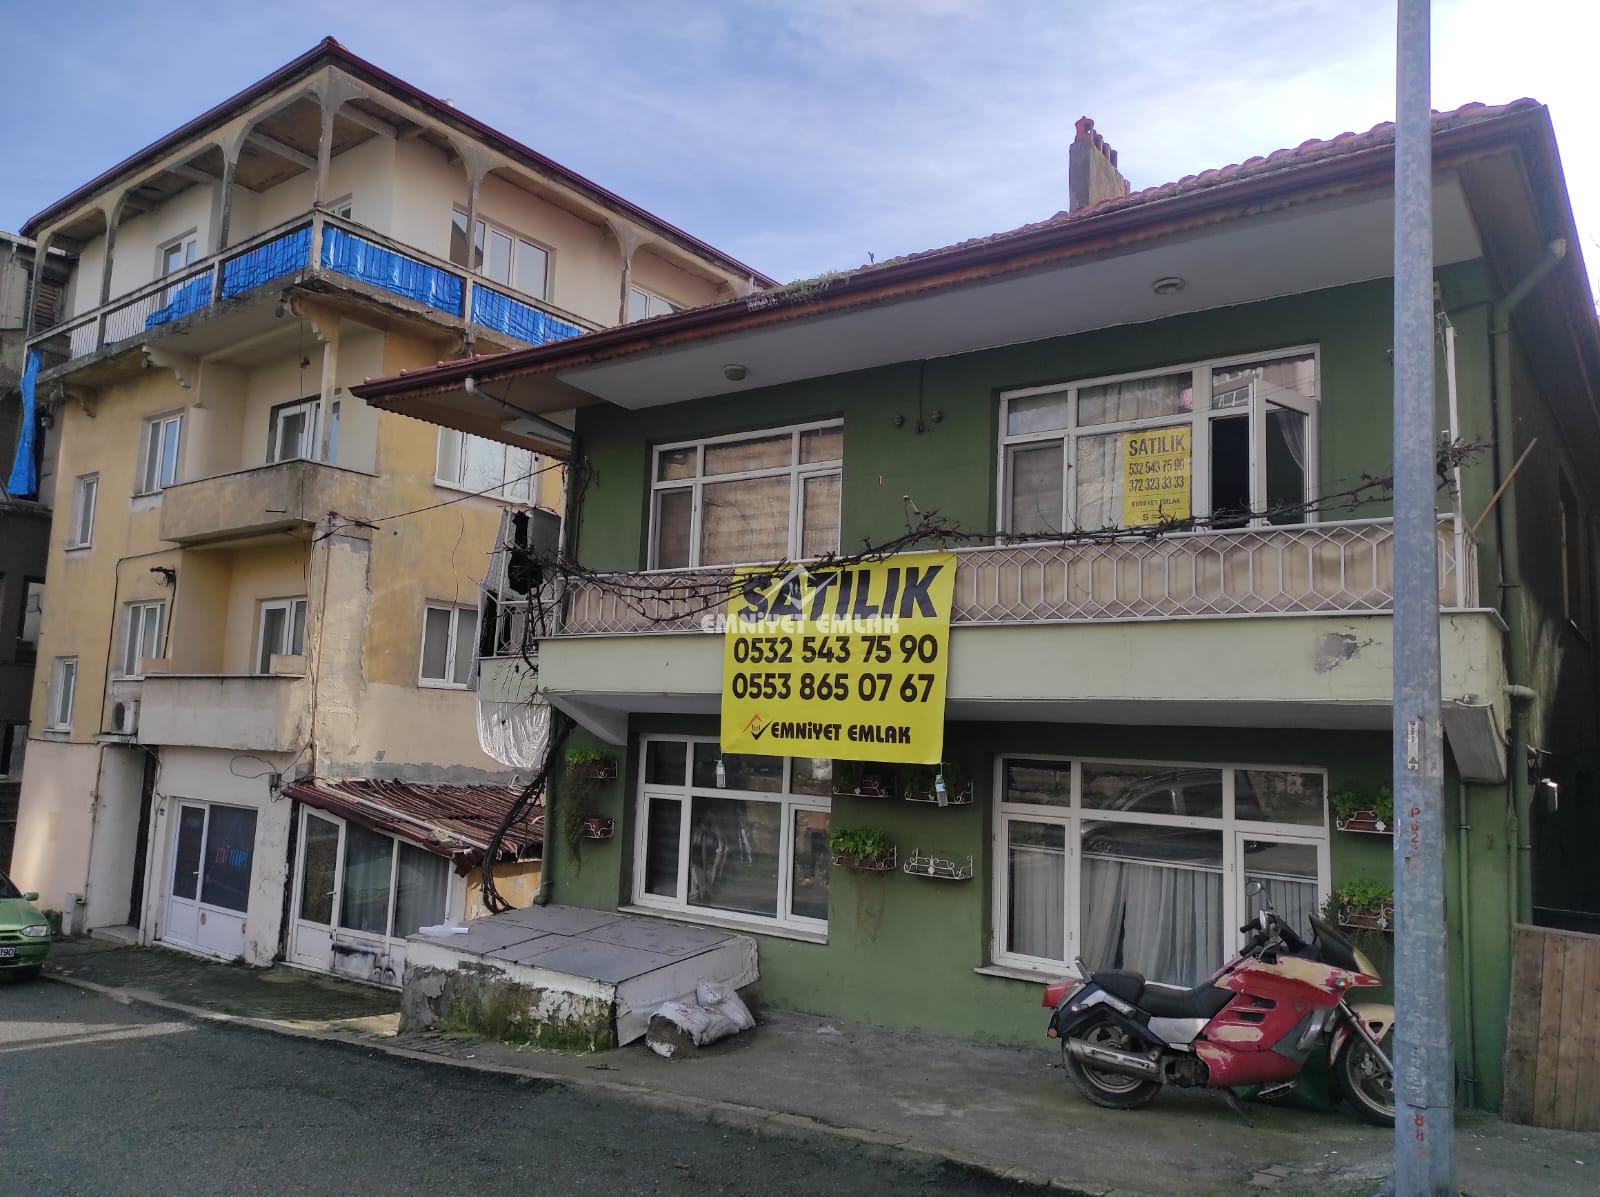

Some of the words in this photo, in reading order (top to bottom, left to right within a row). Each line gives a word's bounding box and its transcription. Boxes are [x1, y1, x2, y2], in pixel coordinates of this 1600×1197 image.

[1129, 435, 1186, 457] SATILIK
[1129, 479, 1143, 492] 372
[1145, 477, 1159, 490] 323
[737, 565, 944, 624] SATILIK
[734, 637, 793, 663] 0532
[802, 636, 851, 663] 543
[861, 636, 891, 662] 75
[900, 634, 938, 663] 90
[732, 673, 792, 700] 0553
[799, 673, 849, 701] 865
[858, 673, 892, 702] 07
[900, 673, 935, 702] 67
[847, 724, 910, 744] EMLAK
